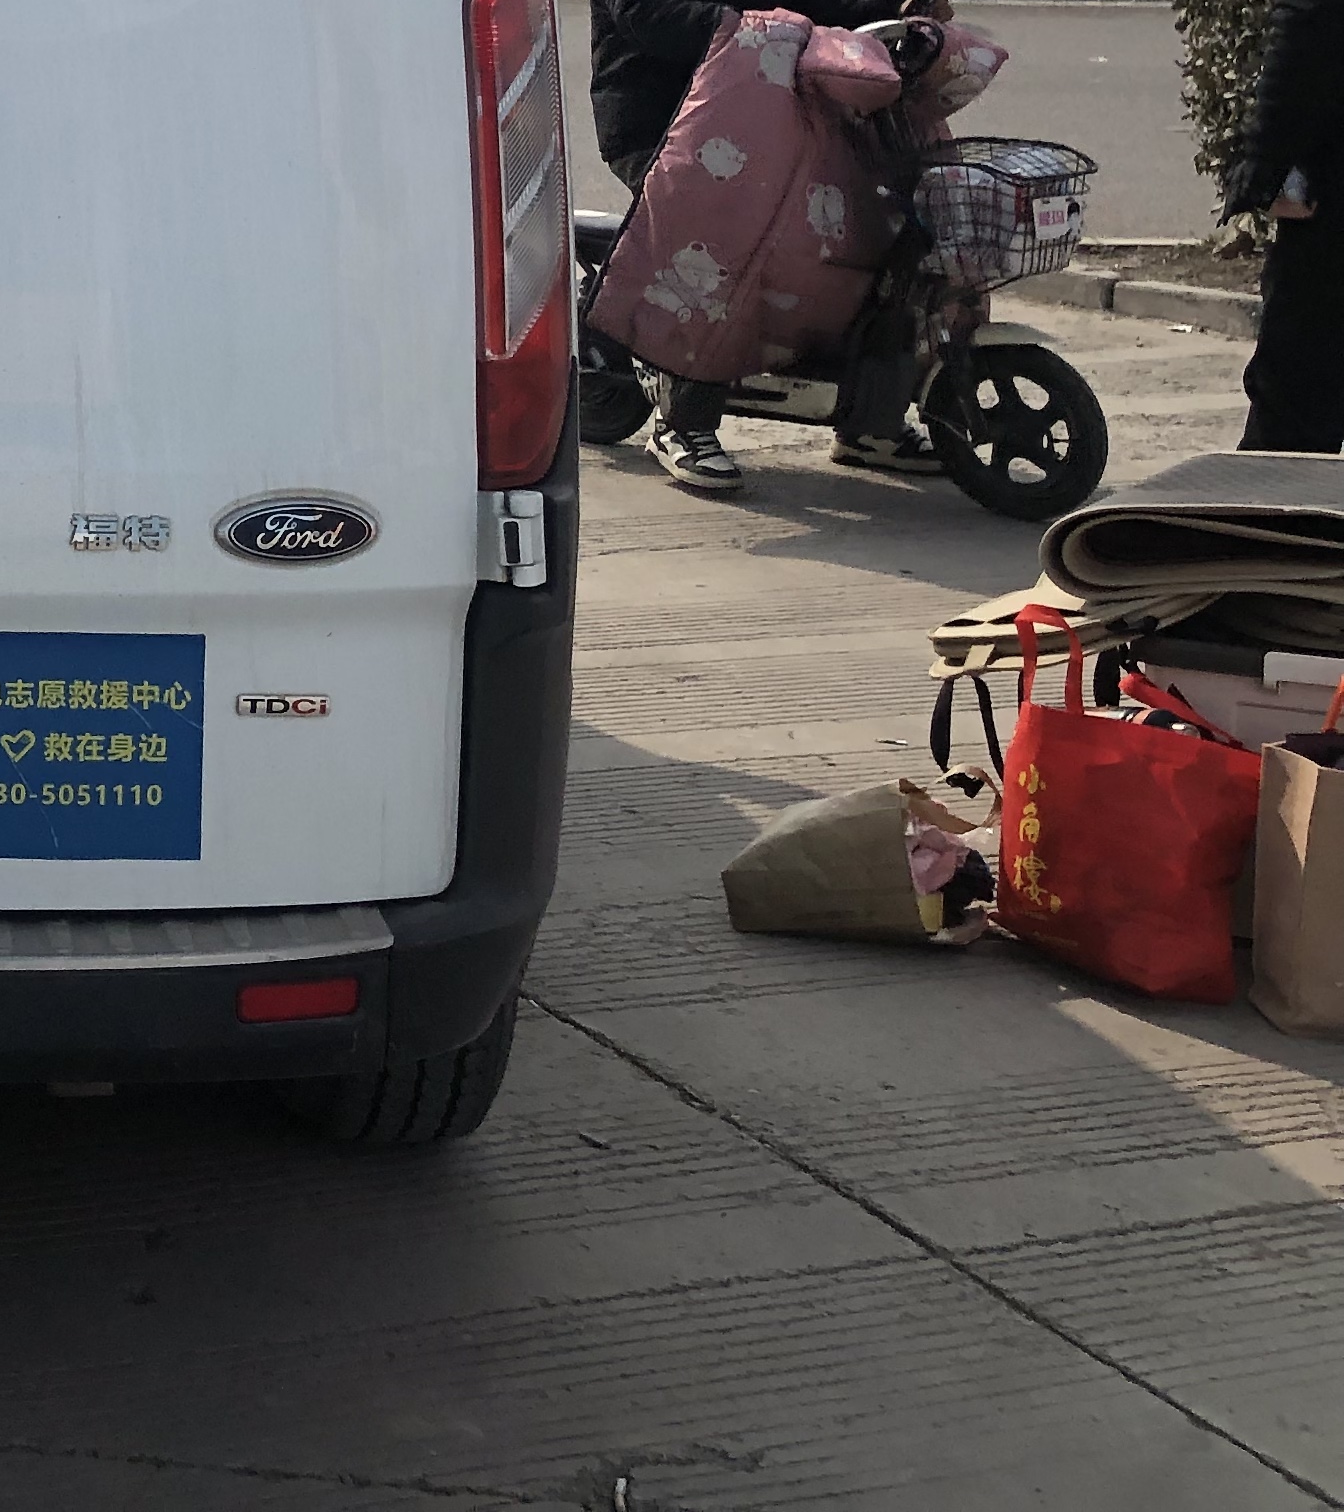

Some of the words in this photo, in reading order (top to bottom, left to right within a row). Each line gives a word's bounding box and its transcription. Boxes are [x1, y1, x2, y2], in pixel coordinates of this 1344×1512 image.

[69, 512, 173, 553] 福特
[255, 512, 346, 551] Ford
[242, 697, 328, 715] TDCi
[43, 732, 169, 763] 救在身边
